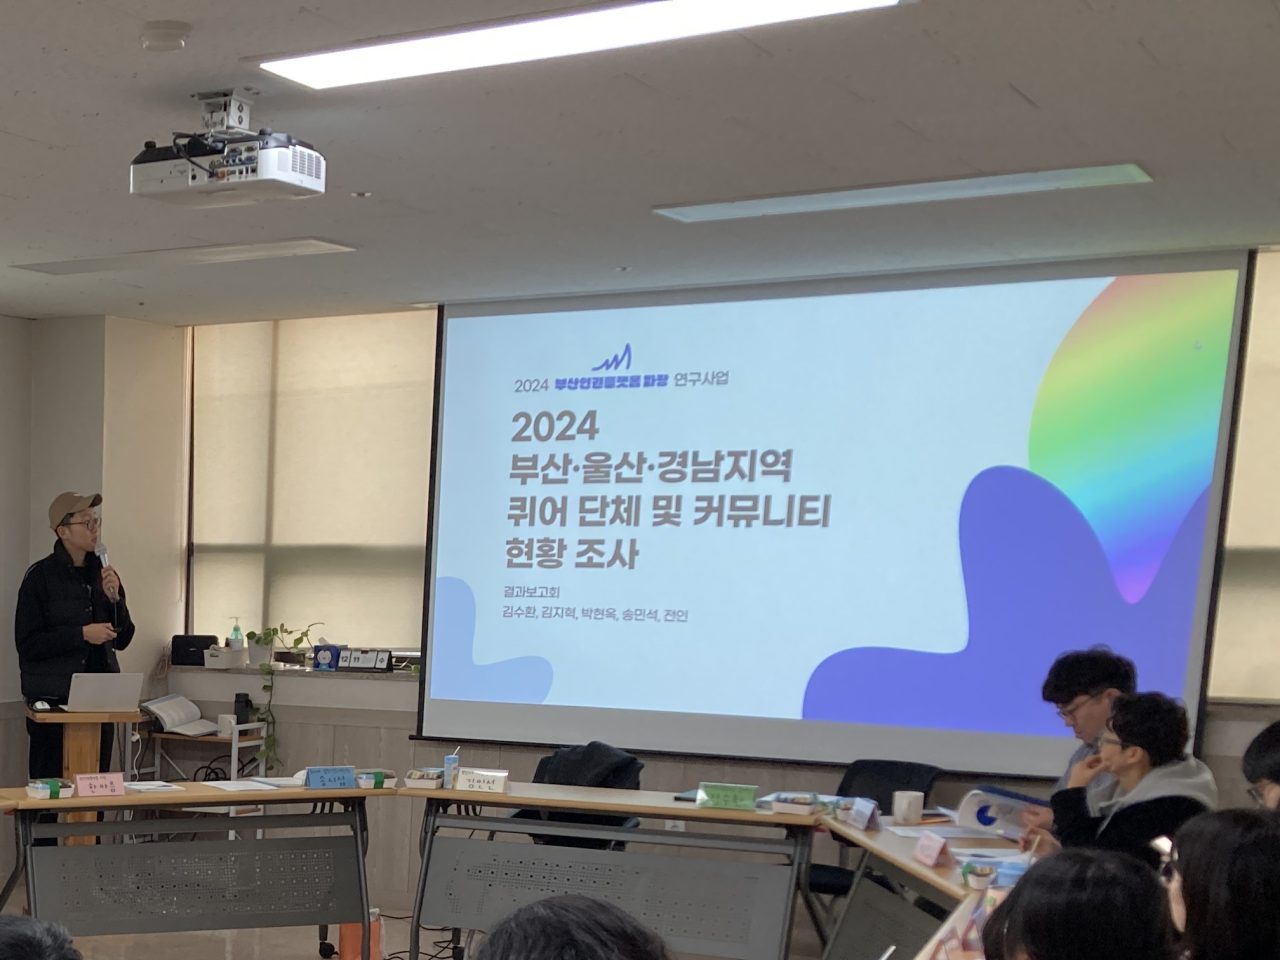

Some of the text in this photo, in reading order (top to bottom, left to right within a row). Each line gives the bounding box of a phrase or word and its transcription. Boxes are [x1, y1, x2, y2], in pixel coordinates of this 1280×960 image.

[514, 371, 729, 393] 2024 부산인권플랫폼 파랑 연구사업
[511, 410, 599, 443] 2024
[509, 449, 793, 485] 부산·울산·경남지역
[507, 494, 832, 528] 퀴어 단체 및 커뮤니티
[506, 537, 639, 570] 현황 조사
[504, 585, 560, 599] 결과보고회
[622, 608, 661, 623] 송민석,
